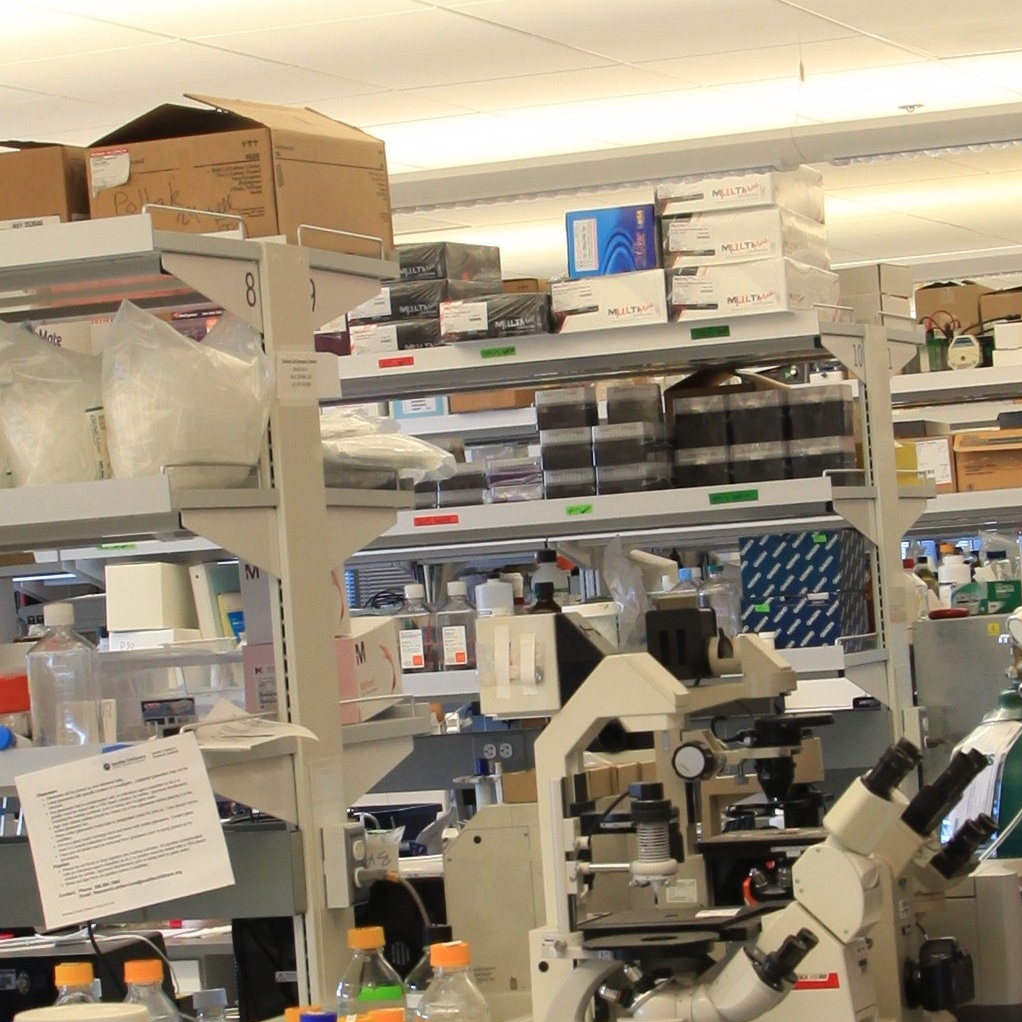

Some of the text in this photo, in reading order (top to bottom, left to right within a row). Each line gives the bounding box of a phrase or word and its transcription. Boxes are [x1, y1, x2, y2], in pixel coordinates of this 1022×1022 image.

[245, 271, 256, 307] 8
[245, 564, 260, 580] M
[355, 641, 366, 666] M
